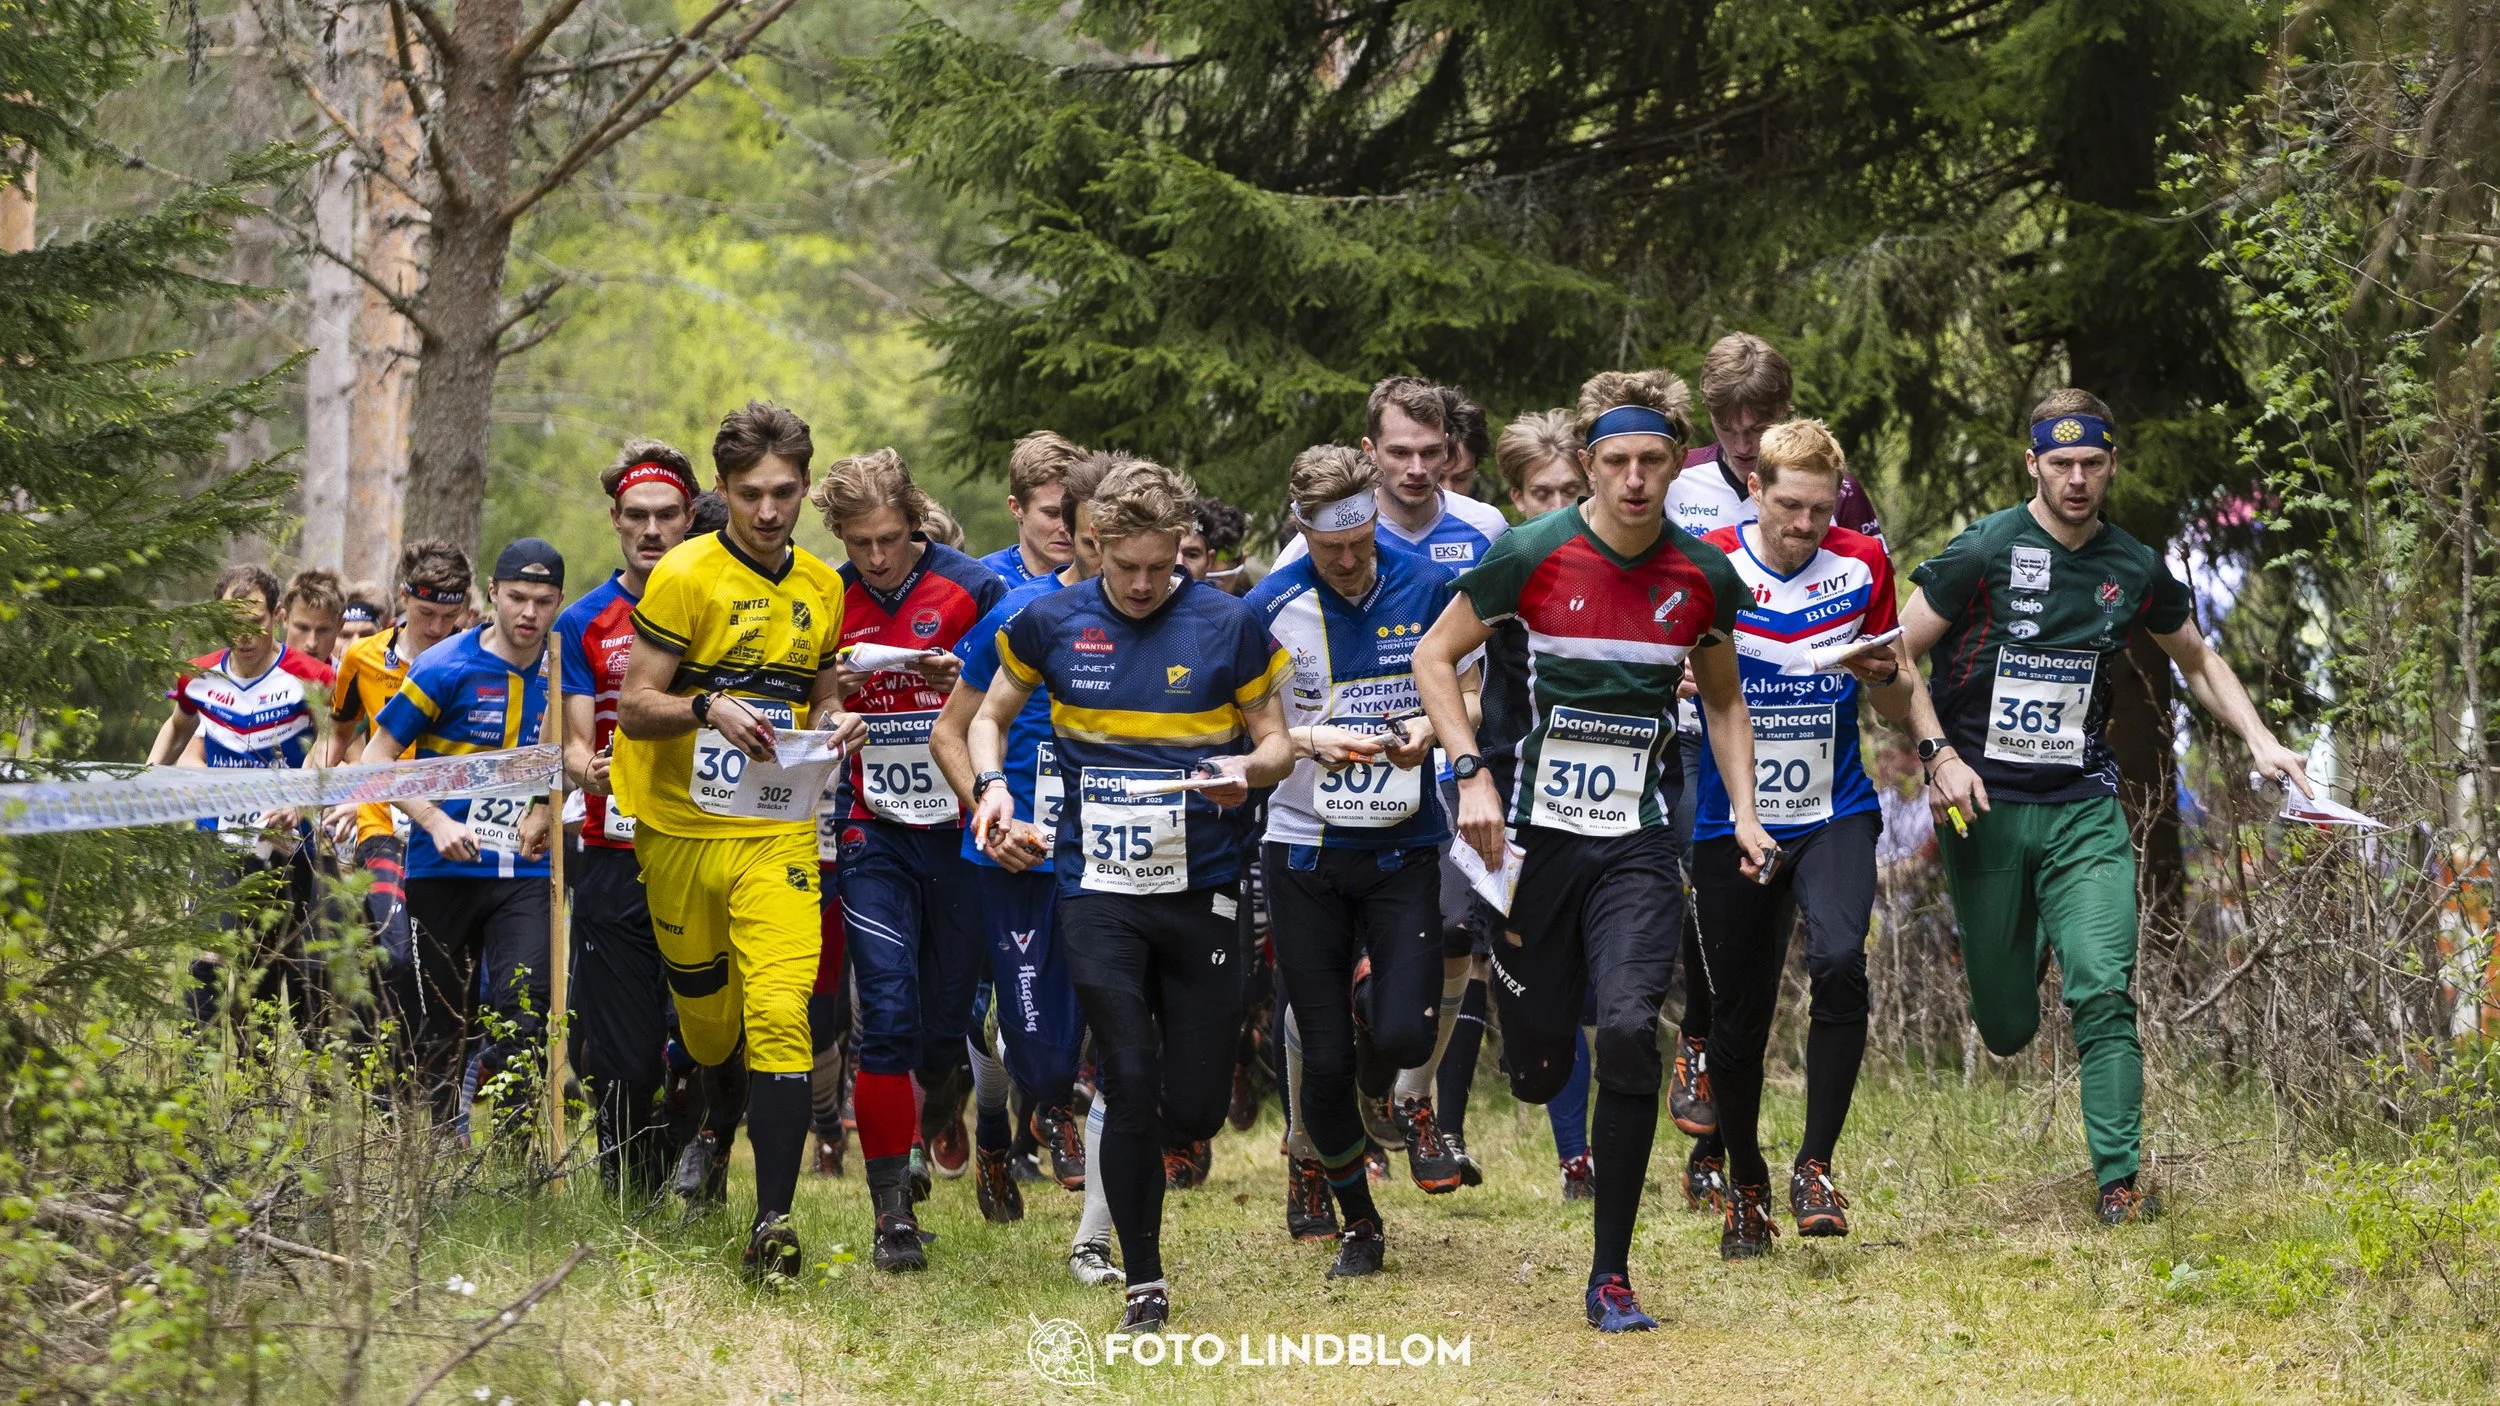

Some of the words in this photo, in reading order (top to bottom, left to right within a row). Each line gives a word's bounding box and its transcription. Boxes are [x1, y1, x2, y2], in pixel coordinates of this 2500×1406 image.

[1679, 502, 1719, 517] Sydved
[1335, 515, 1366, 528] SOCKS
[893, 571, 919, 601] UPPSALA
[1823, 573, 1848, 594] IVT
[1266, 582, 1302, 613] noname
[1363, 574, 1386, 612] noname
[732, 599, 770, 611] TRIMTEX
[1804, 598, 1852, 623] BIOS
[601, 634, 634, 649] TRIMTE
[844, 625, 880, 640] noname
[1081, 627, 1107, 641] ICA
[1075, 643, 1113, 651] KVANTUM
[787, 652, 808, 665] SSAB
[2002, 650, 2093, 671] bagheera
[1070, 664, 1110, 673] JUNET
[1071, 680, 1112, 690] TRIMTEX
[1341, 677, 1417, 699] SÖDERTÄL
[270, 690, 290, 703] IVT
[2078, 687, 2085, 705] 1
[255, 706, 290, 724] BIOS
[1750, 713, 1831, 729] agheera
[1995, 697, 2066, 735] 363
[1554, 713, 1653, 740] bagheera
[1581, 735, 1610, 743] STAFETT
[1613, 738, 1630, 746] 2025
[1820, 742, 1828, 760] 1
[697, 747, 747, 784] 30
[1632, 752, 1642, 772] 1
[867, 762, 933, 796] 305
[1320, 761, 1394, 793] 307
[1544, 759, 1616, 802] 310
[1754, 759, 1811, 793] 20
[759, 786, 793, 803] 302
[474, 797, 527, 828] 327
[783, 803, 788, 811] 1
[1168, 810, 1177, 828] 1
[1091, 824, 1154, 861] 315
[656, 917, 685, 936] TRIMTEX
[1017, 962, 1040, 1032] Hagaby
